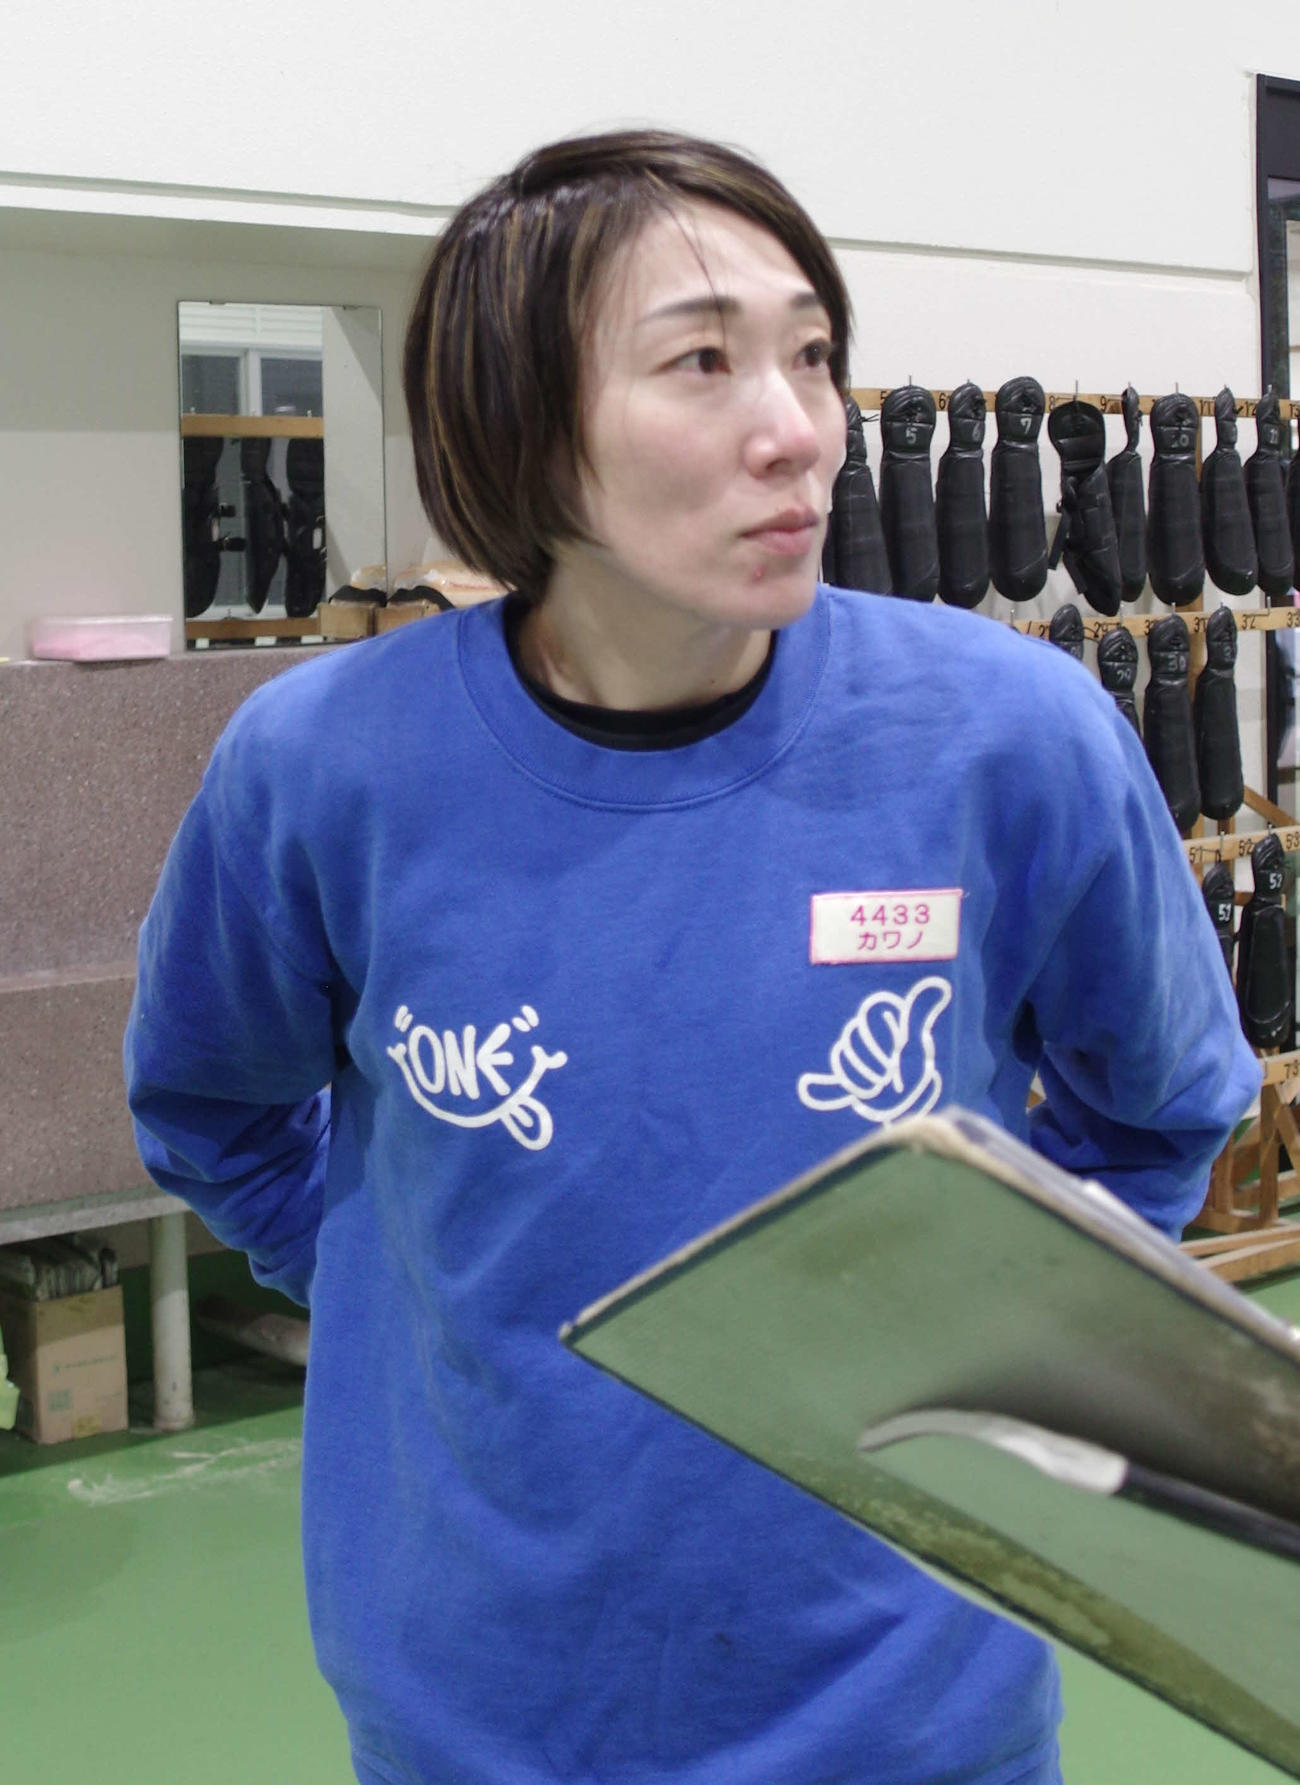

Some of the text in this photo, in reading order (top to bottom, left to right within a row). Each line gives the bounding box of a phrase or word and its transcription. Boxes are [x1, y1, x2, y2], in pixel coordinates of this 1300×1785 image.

[938, 392, 946, 410] 6
[1049, 395, 1056, 411] 8
[1100, 395, 1107, 412] 9
[1199, 400, 1212, 416] 11
[1020, 416, 1032, 435] 7
[905, 426, 918, 445] 5
[1144, 619, 1155, 636] 3
[1241, 613, 1256, 630] 32
[1238, 838, 1254, 857] 52
[850, 903, 931, 927] 4433
[857, 930, 924, 951] カワノ
[408, 1023, 515, 1100] ONE
